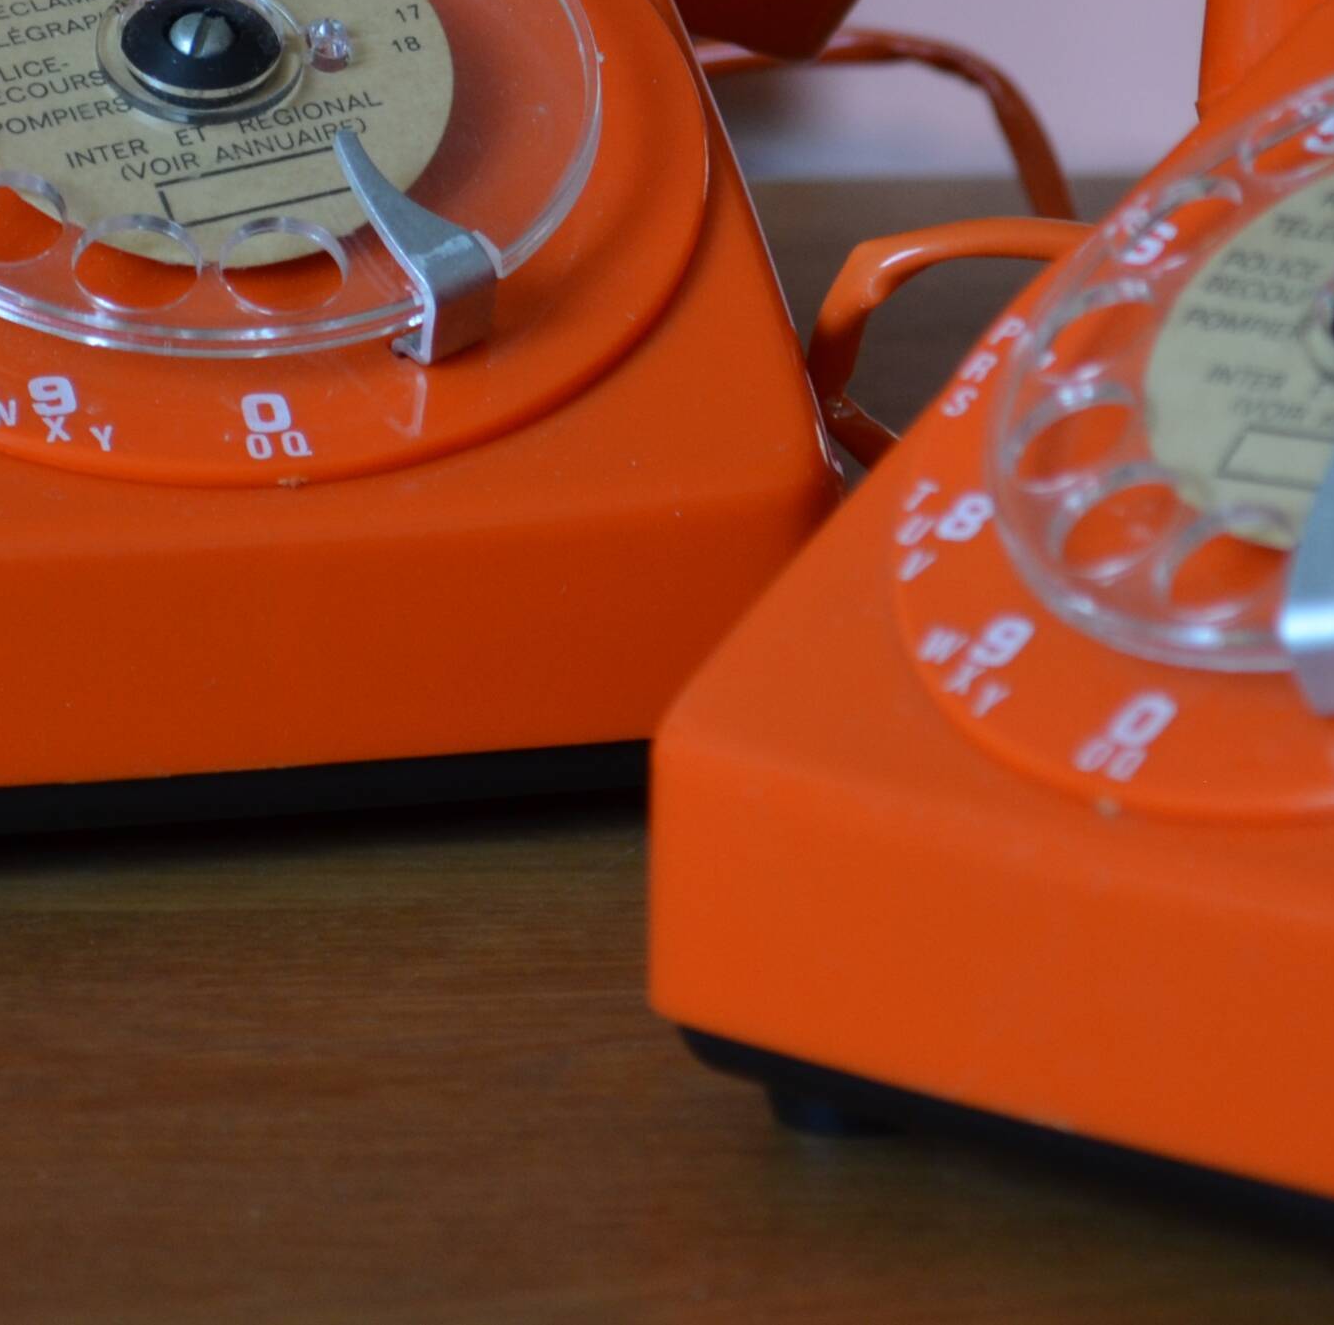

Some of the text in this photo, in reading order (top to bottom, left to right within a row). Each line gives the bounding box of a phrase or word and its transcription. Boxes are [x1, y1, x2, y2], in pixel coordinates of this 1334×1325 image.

[395, 4, 421, 23] 17
[392, 36, 422, 53] 18
[64, 138, 150, 170] INTER
[175, 126, 210, 148] ET
[119, 152, 200, 183] (VOIR
[27, 376, 77, 416] 9
[935, 491, 995, 542] 8
[969, 614, 1035, 668] 9
